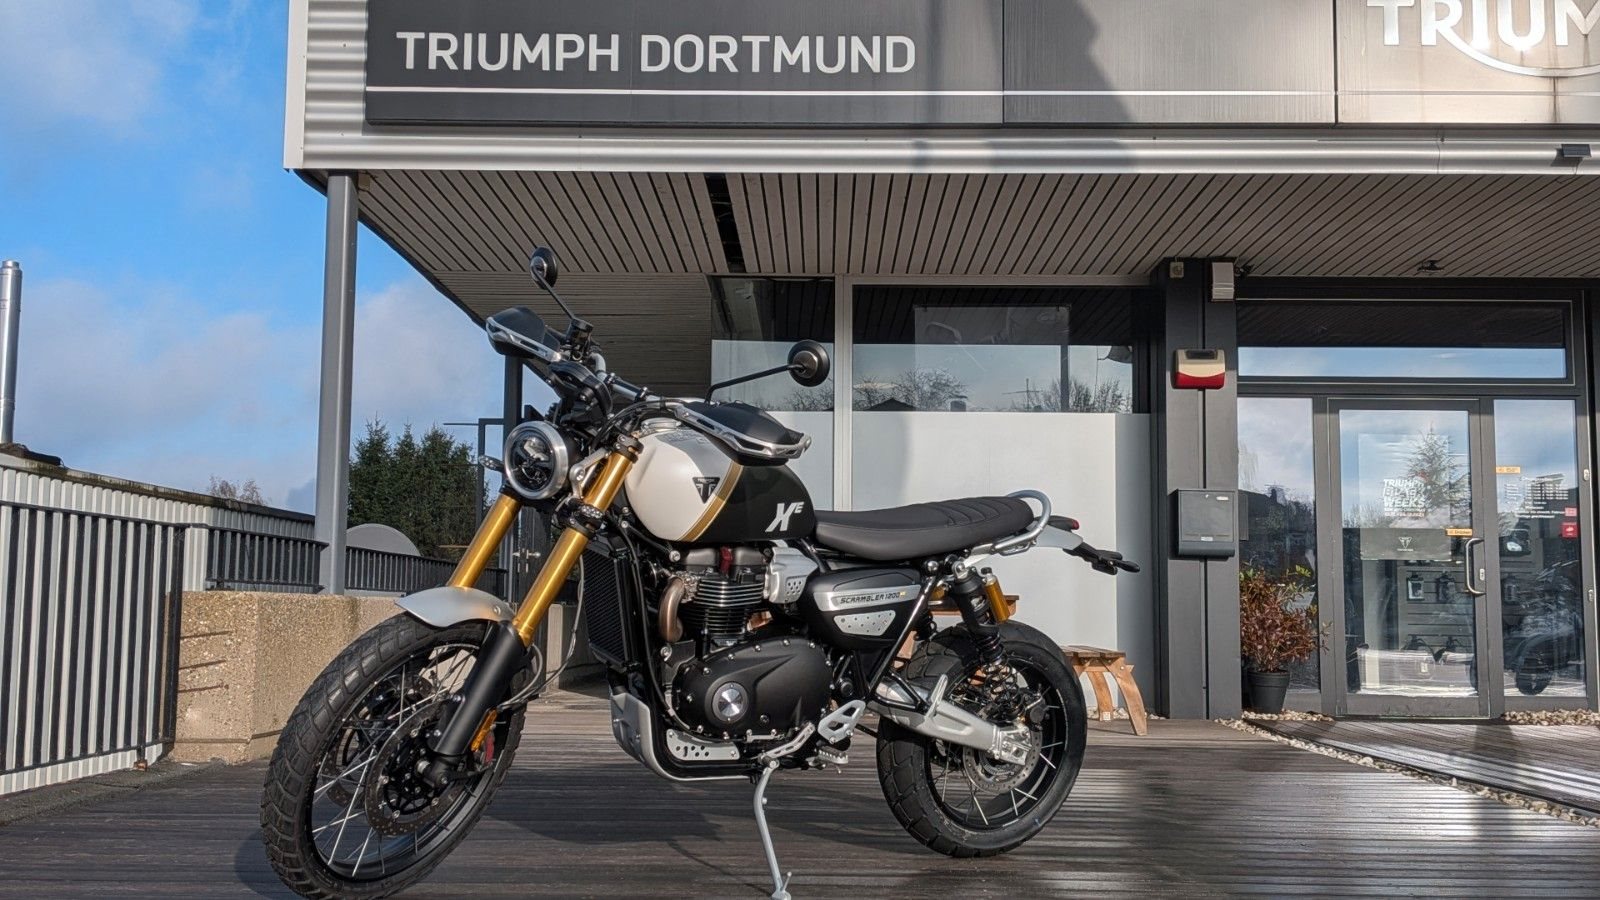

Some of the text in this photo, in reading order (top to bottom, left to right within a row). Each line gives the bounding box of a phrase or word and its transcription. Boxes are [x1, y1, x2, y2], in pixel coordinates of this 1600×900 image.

[396, 31, 916, 74] TRIUMPH DORTMUND
[1384, 497, 1426, 508] WEEKS
[840, 594, 884, 604] SCRAMBLER
[885, 592, 900, 600] 1200
